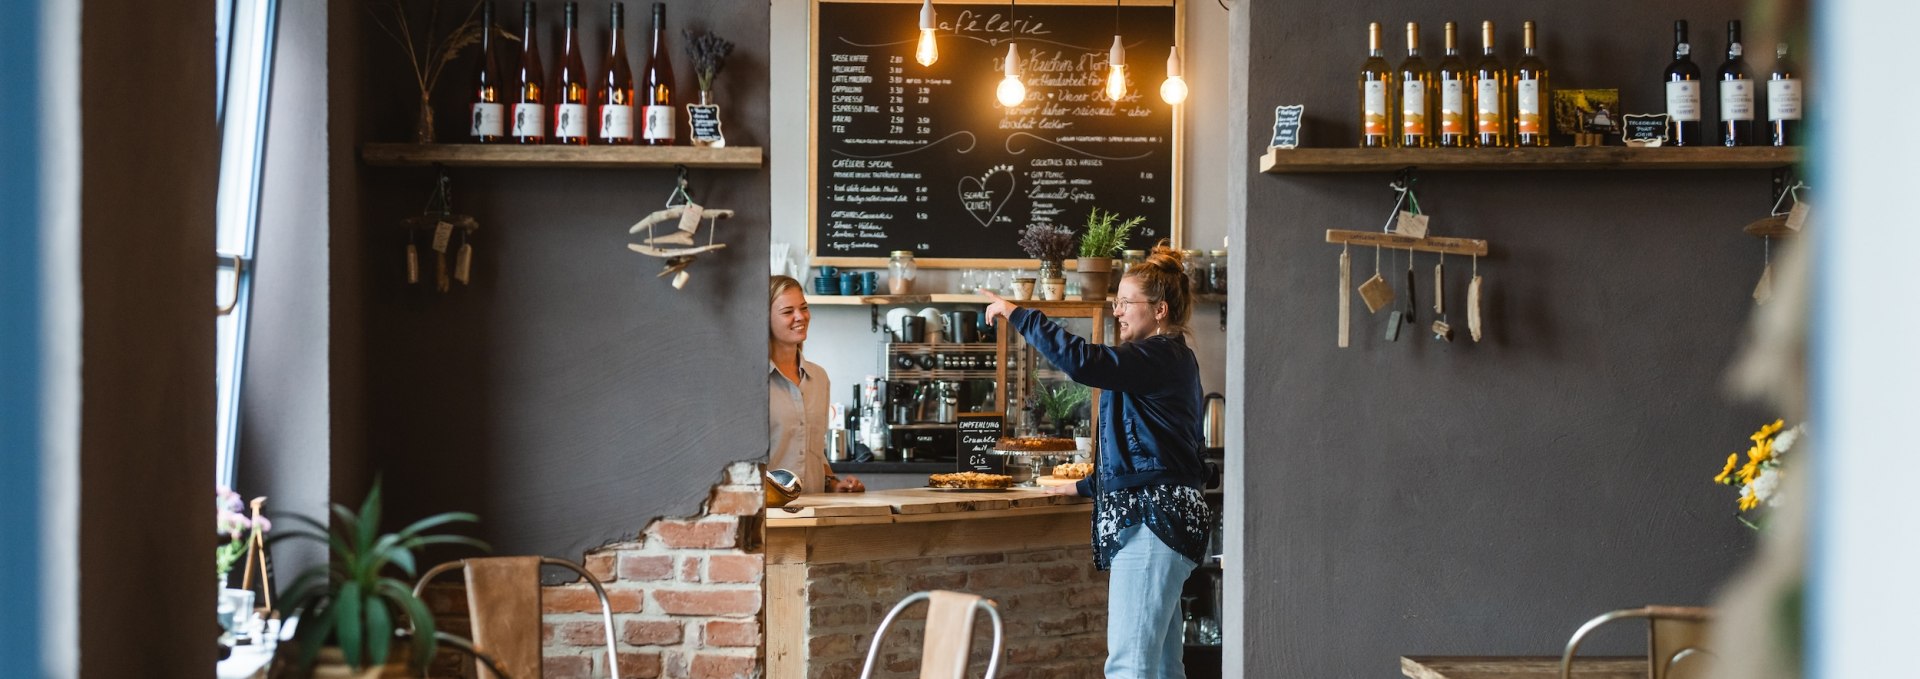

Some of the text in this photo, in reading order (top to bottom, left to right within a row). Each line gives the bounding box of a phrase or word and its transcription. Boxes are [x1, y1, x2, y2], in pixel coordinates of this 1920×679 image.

[934, 9, 1052, 34] afélerie
[831, 95, 864, 103] ESPRESSO
[831, 104, 863, 113] ESPRESSO
[831, 125, 846, 133] TEE
[958, 421, 1000, 429] EMPFEHLUNG
[962, 435, 996, 443] Crumble
[969, 453, 986, 465] Eis
